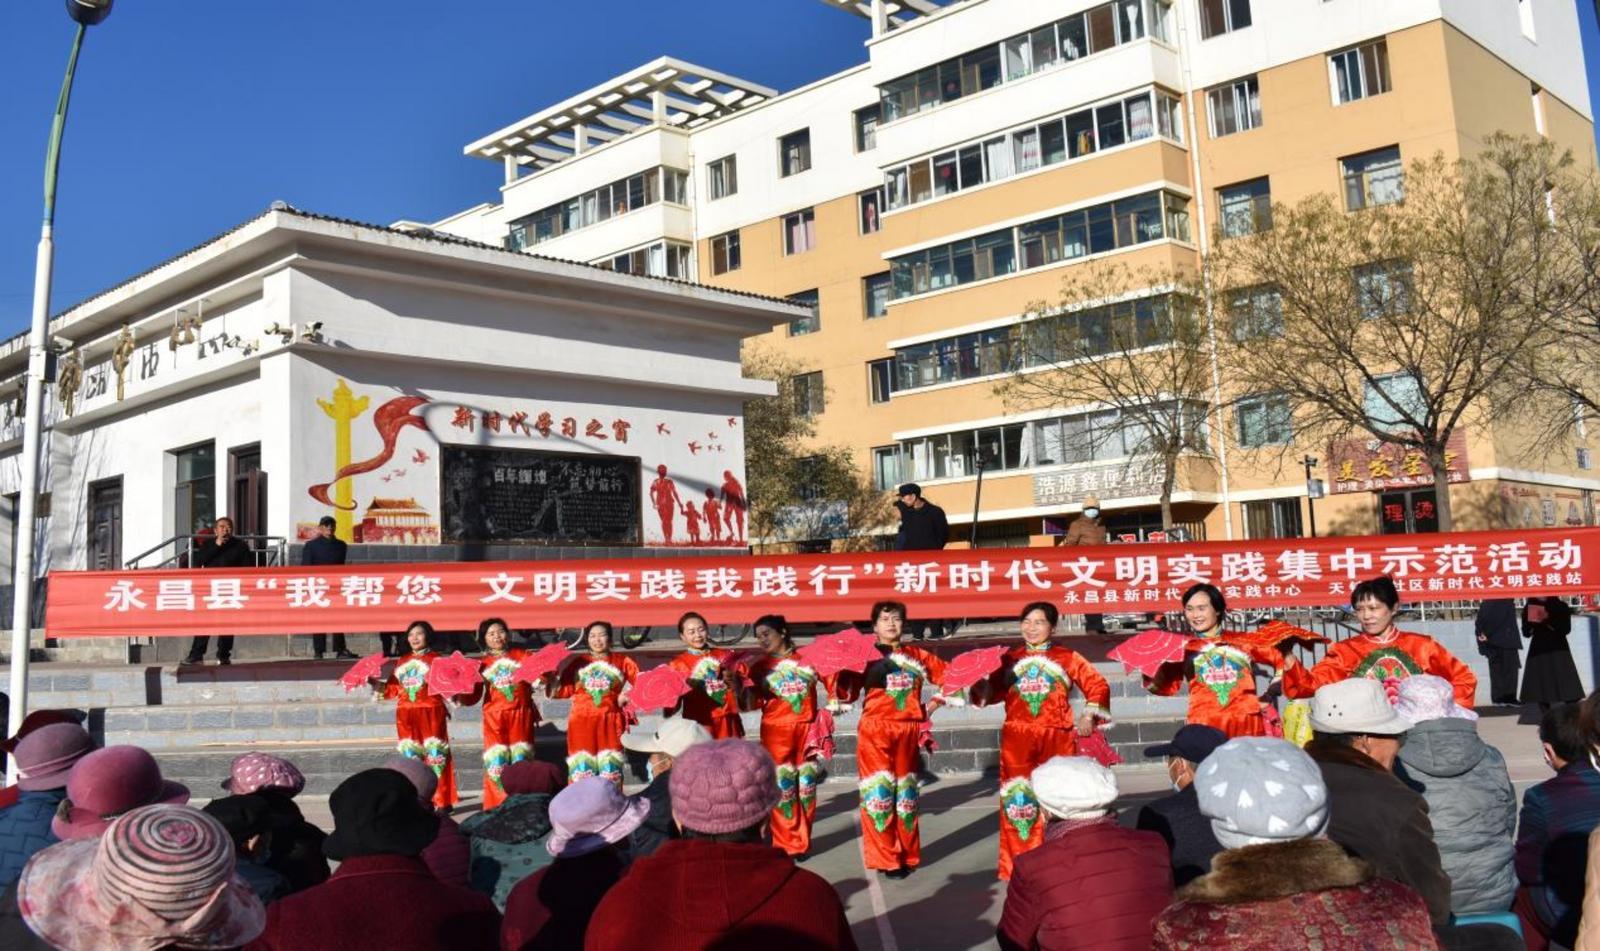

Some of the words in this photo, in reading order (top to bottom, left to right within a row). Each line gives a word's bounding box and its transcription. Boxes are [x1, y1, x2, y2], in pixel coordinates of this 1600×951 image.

[451, 405, 632, 444] 新时代学习之窗
[1038, 464, 1167, 495] 浩源鑫便利店
[103, 574, 443, 612] 永昌县“我帮您
[479, 538, 1584, 604] 文明实践我践行”新时代文明实践集中示范活动
[1329, 572, 1583, 595] 天社区新时代文明实践站
[1064, 584, 1302, 604] 永昌县新时代实践中心
